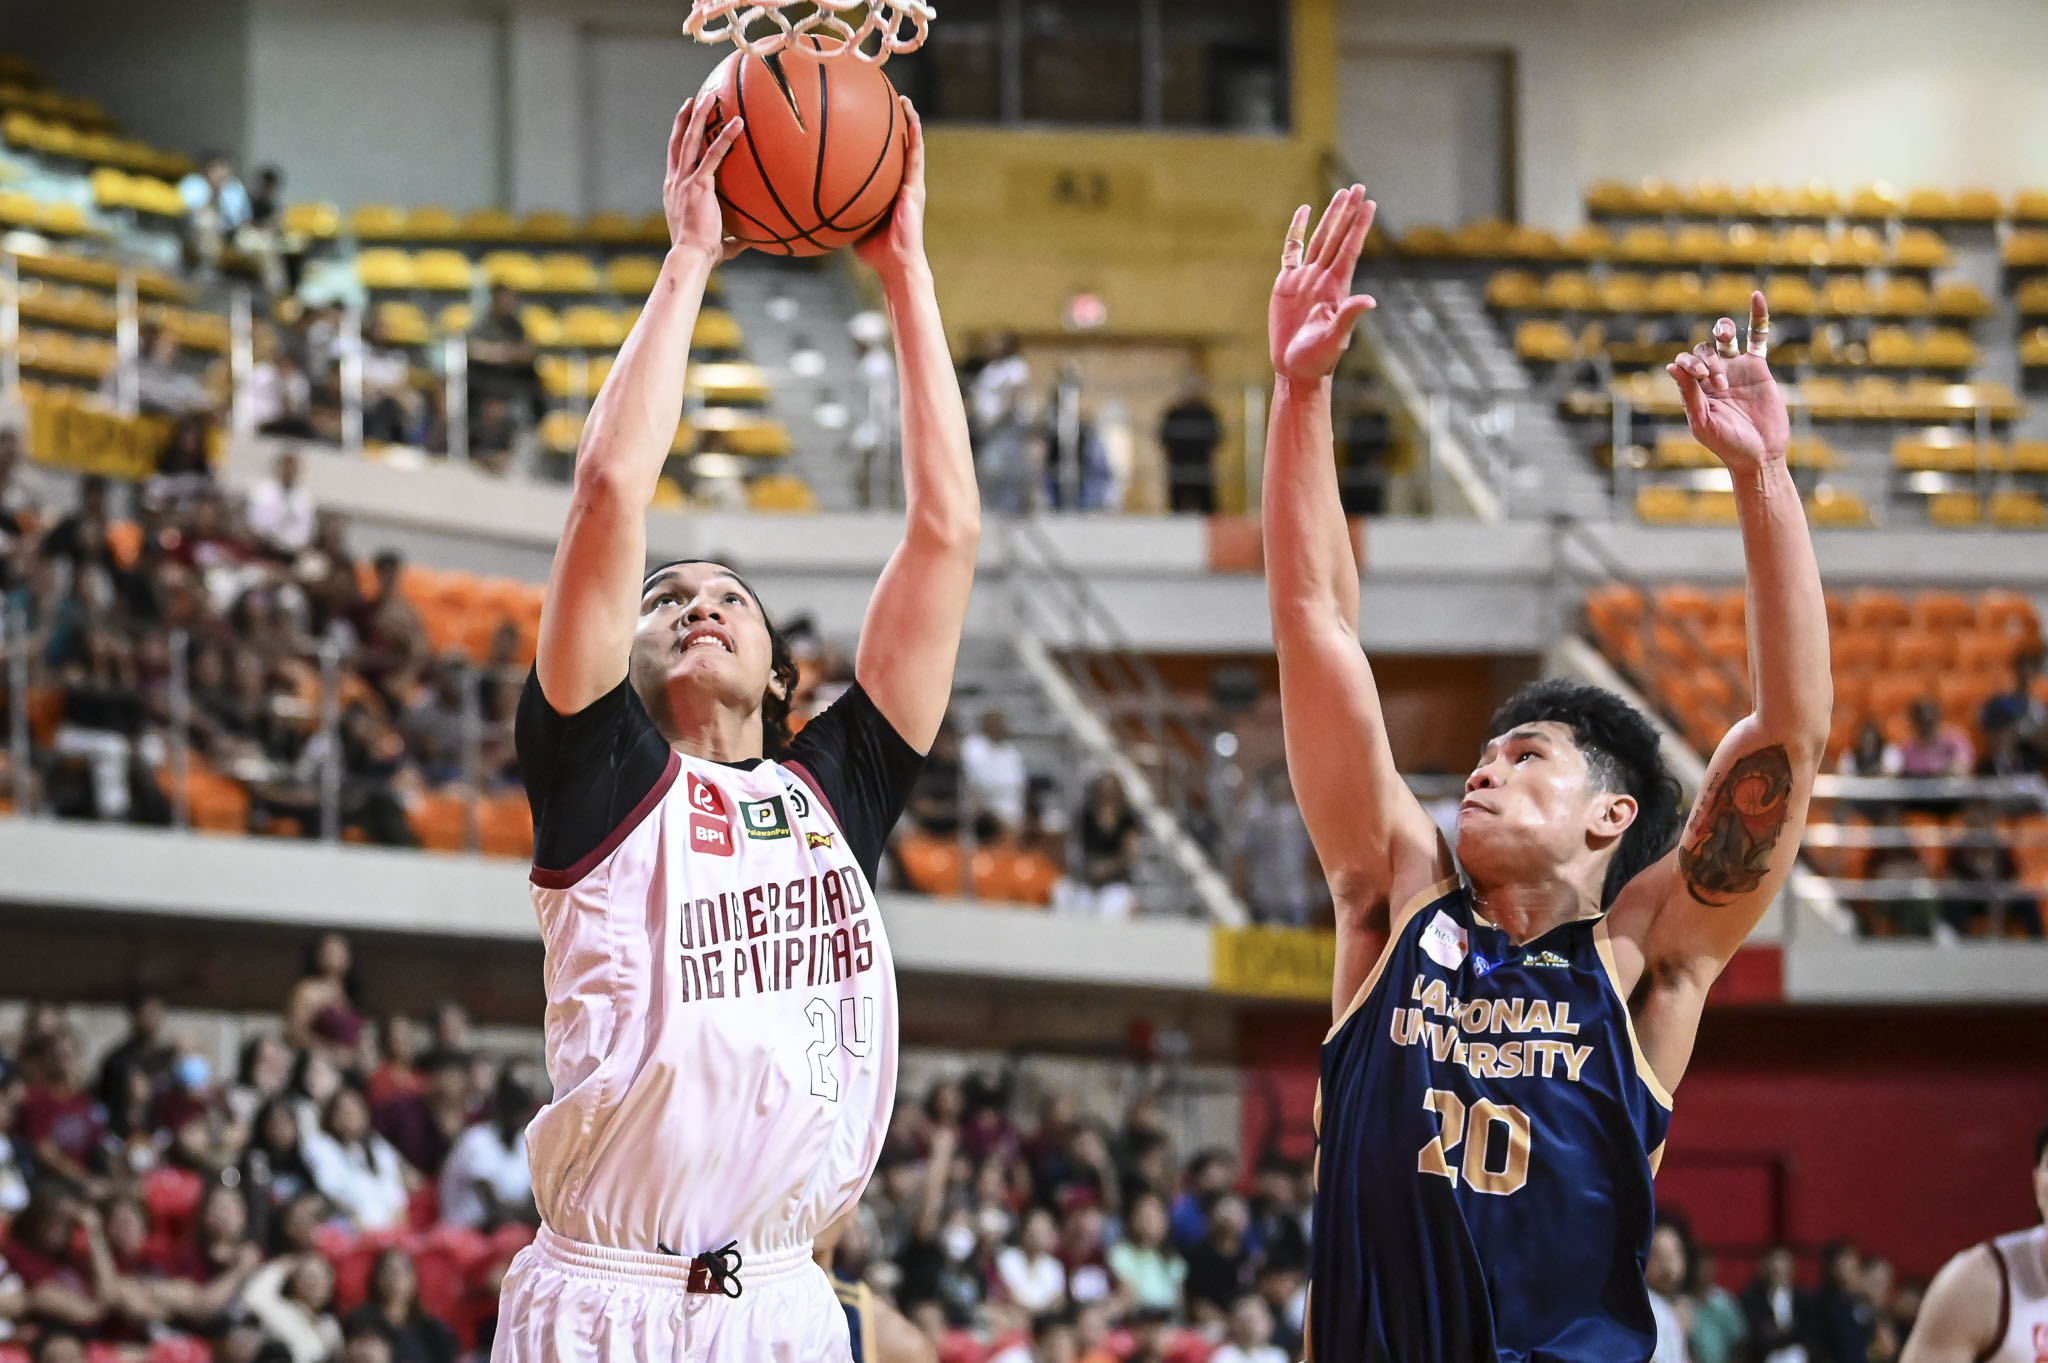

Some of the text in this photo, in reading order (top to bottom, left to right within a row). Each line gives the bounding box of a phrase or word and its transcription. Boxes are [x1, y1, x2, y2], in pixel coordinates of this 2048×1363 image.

[695, 826, 725, 846] BPI
[681, 950, 725, 1003] NG
[1418, 1087, 1532, 1196] 20
